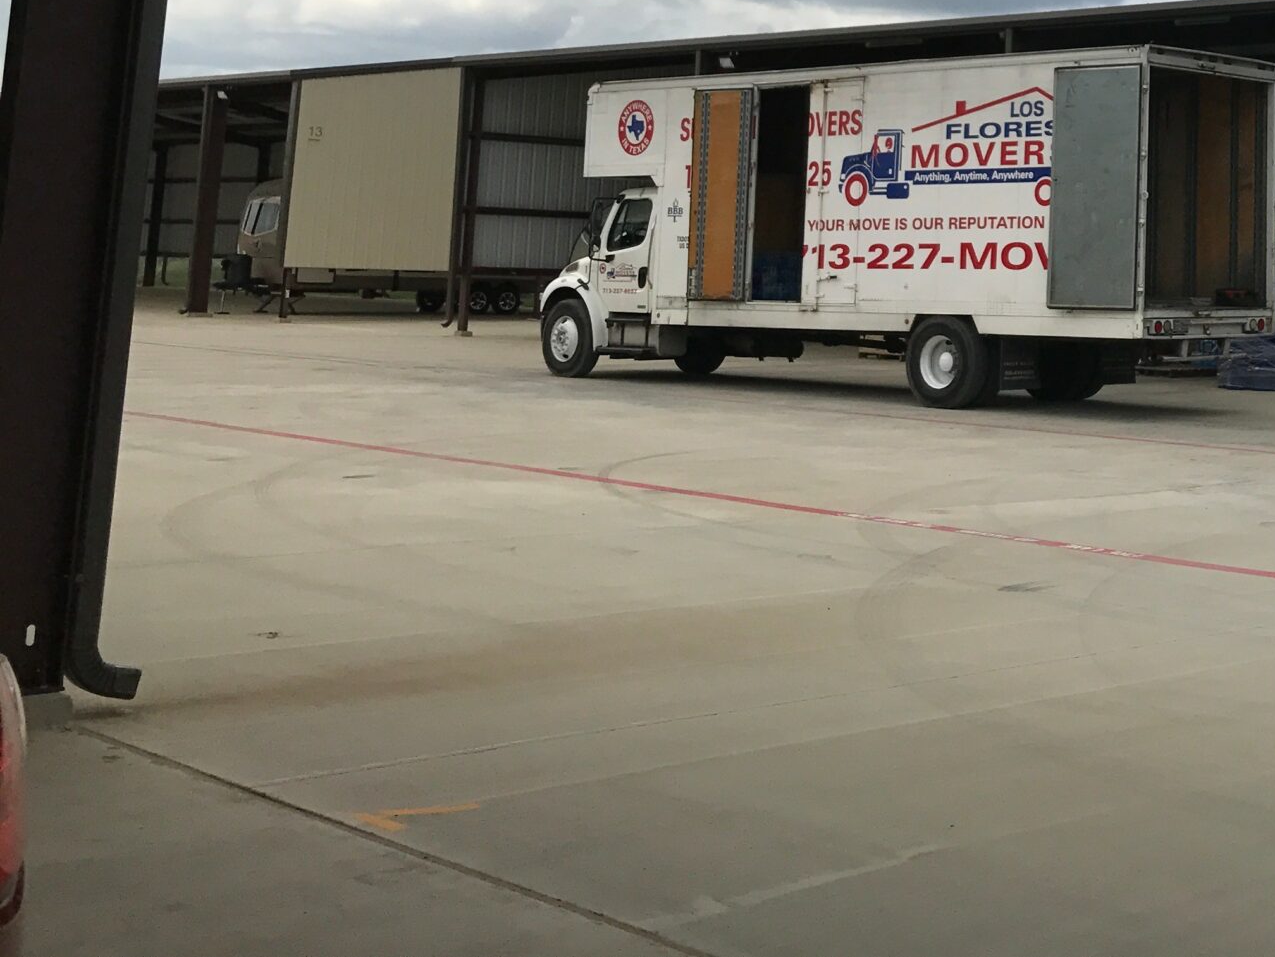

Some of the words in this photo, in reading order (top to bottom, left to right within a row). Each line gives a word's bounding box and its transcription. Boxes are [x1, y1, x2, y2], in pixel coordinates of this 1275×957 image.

[620, 103, 653, 123] ANYWHERE
[1010, 100, 1044, 118] LOS
[309, 126, 322, 137] 13
[621, 137, 631, 152] IN
[628, 138, 650, 155] TEXAS
[910, 140, 1051, 168] MOVER
[913, 171, 952, 184] Anything,
[953, 170, 990, 183] Anytime,
[991, 169, 1034, 182] Anywhere
[667, 206, 684, 215] BBB
[807, 219, 845, 232] YOUR
[849, 218, 890, 232] MOVE
[895, 218, 908, 231] IS
[912, 217, 944, 231] OUR
[948, 215, 1046, 230] REPUTATION
[802, 242, 1049, 271] 13-227-MOV
